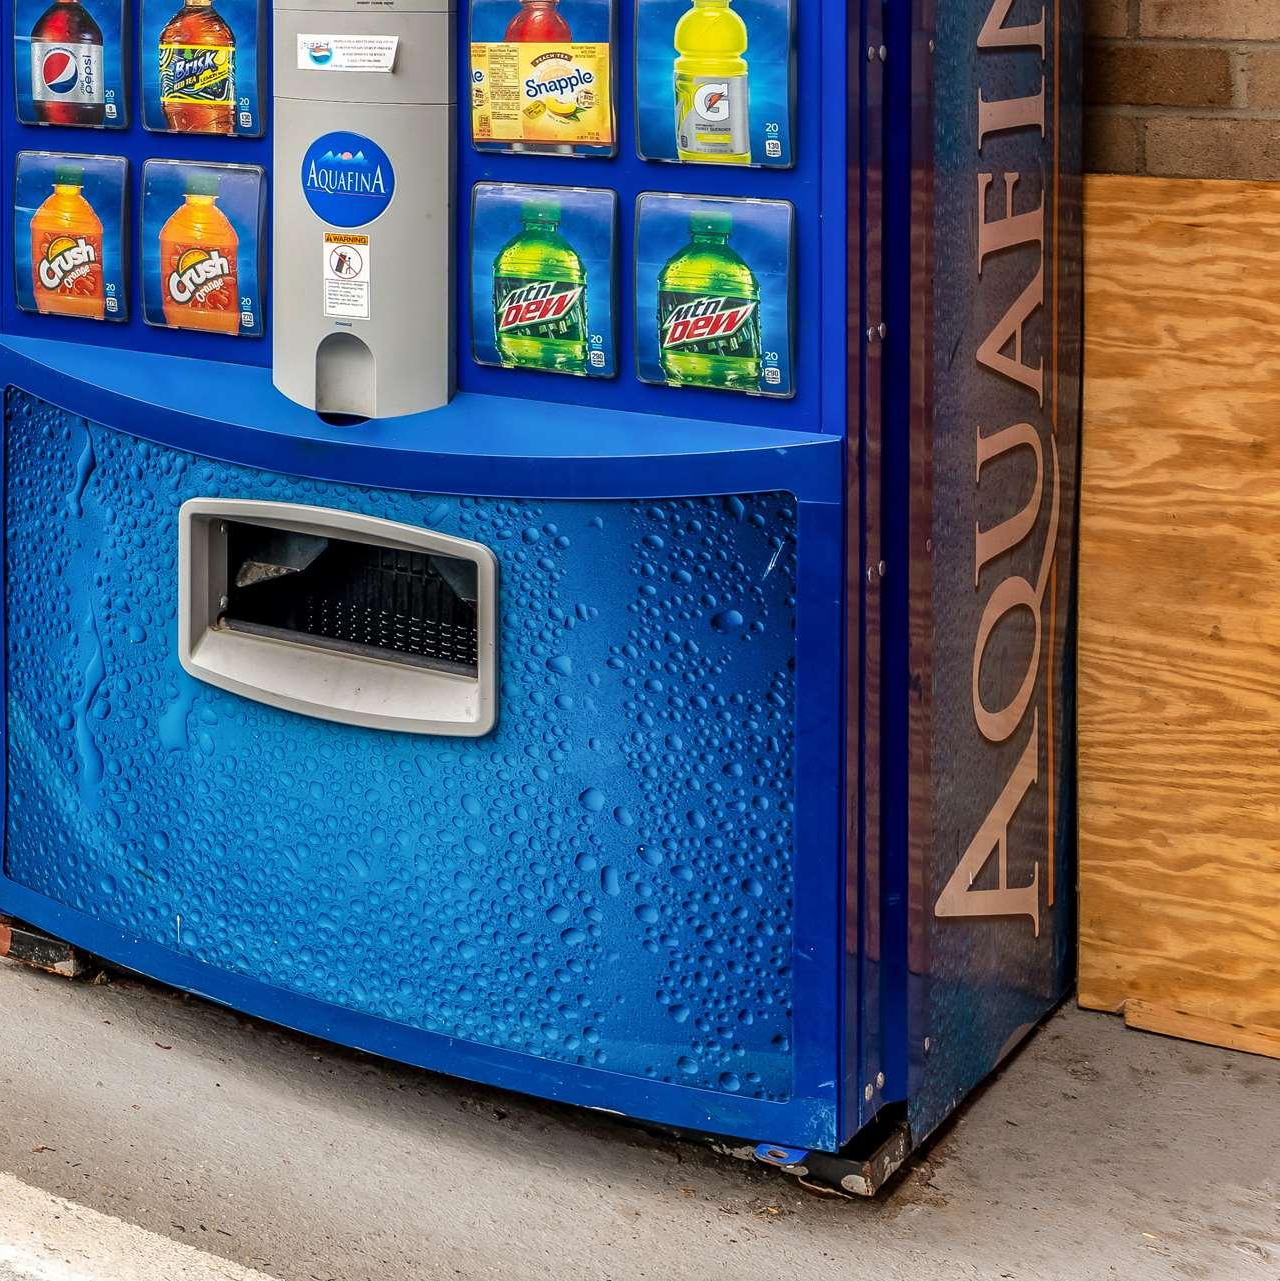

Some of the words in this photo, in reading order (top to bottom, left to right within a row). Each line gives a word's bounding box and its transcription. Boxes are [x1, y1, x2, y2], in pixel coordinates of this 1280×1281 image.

[82, 54, 94, 95] pepsi
[185, 75, 197, 85] TEA
[525, 68, 594, 98] Snapple
[694, 83, 730, 122] G
[765, 123, 779, 132] 20
[306, 160, 386, 193] AQUAFINA
[39, 238, 95, 288] Crush
[169, 251, 229, 302] Crush
[591, 335, 602, 343] 20
[765, 352, 778, 361] 20
